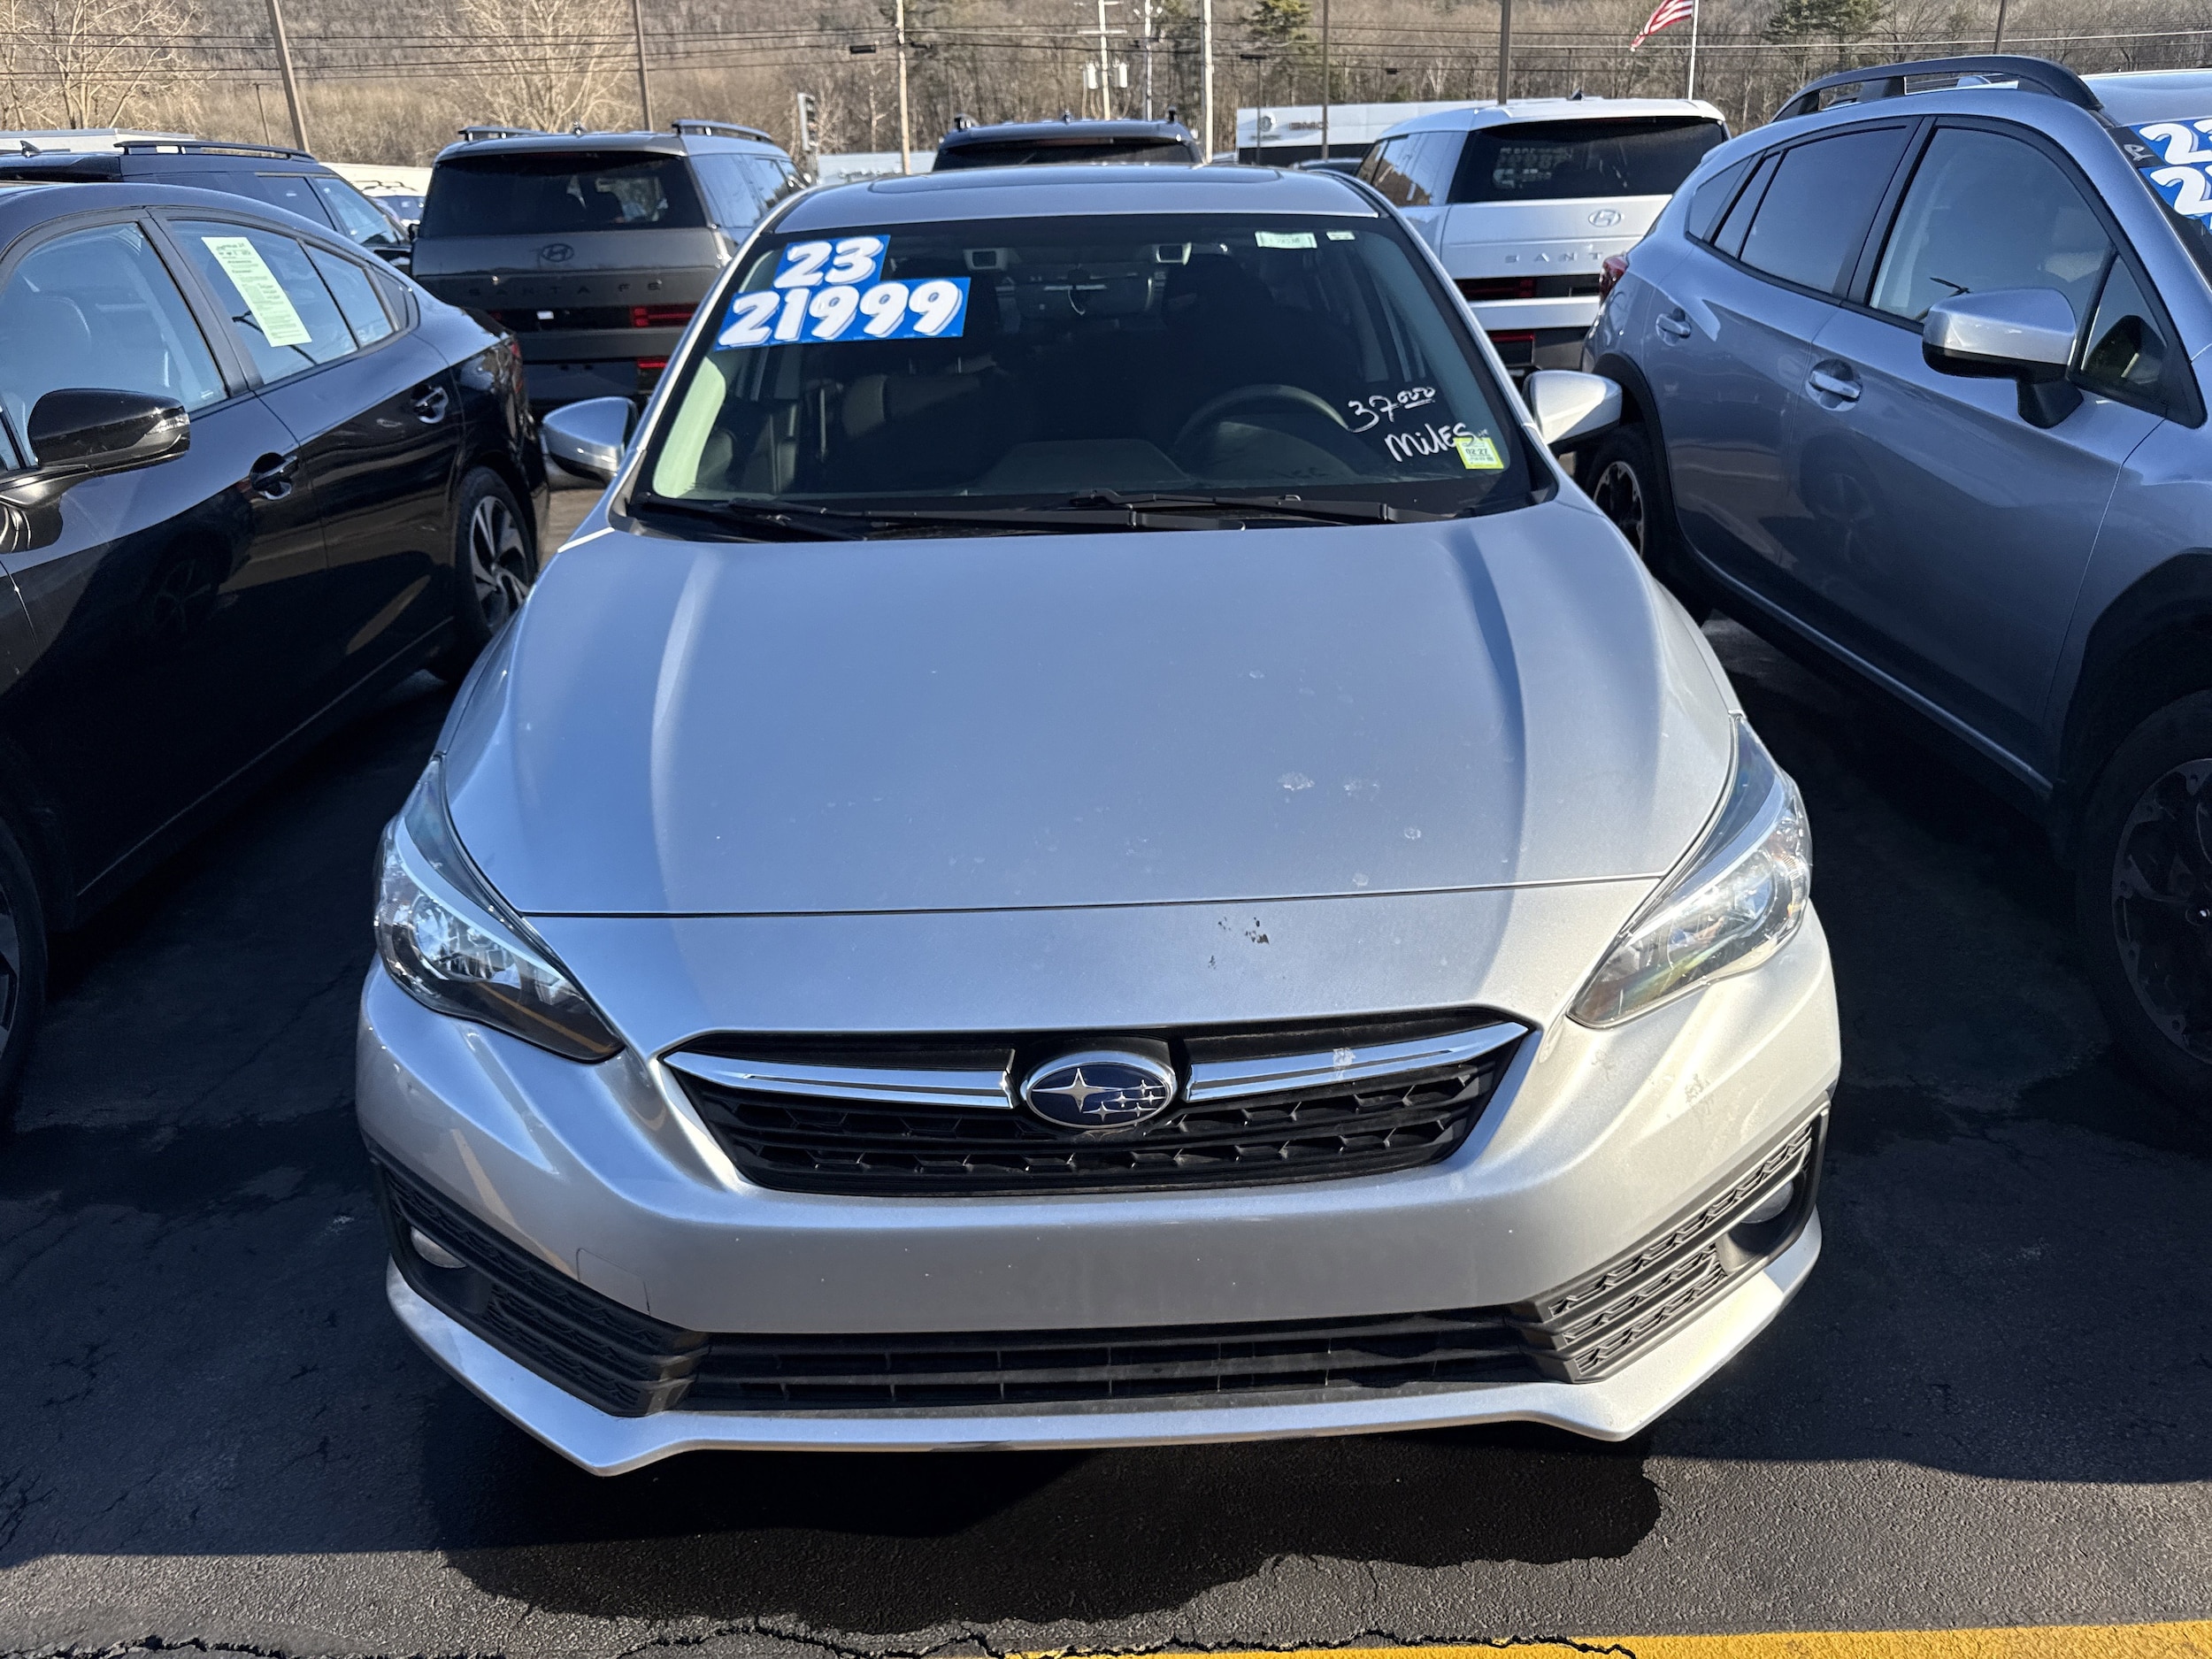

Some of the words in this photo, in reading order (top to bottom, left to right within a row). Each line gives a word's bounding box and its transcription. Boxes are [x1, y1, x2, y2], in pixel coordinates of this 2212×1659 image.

[2150, 165, 2212, 216] 2
[773, 236, 884, 288] 23
[1504, 251, 1603, 264] SANT
[718, 280, 964, 348] 21999
